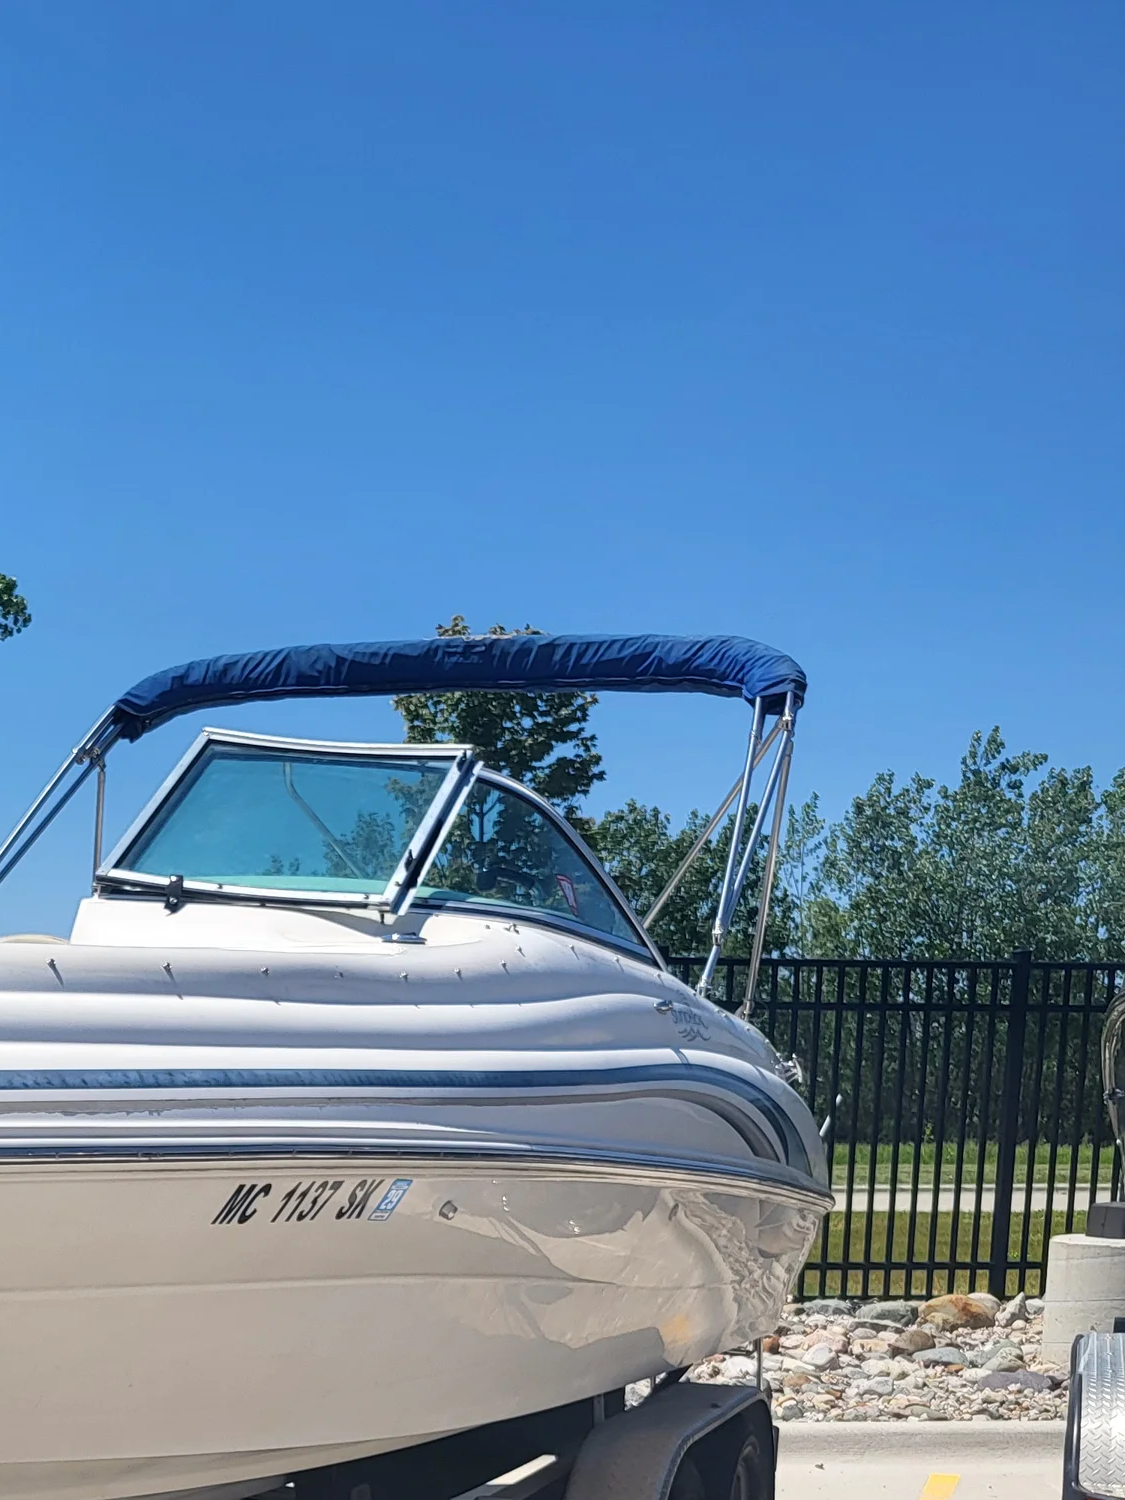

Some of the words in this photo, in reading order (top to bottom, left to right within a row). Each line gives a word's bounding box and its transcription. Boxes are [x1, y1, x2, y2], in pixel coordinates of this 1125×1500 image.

[211, 1183, 272, 1225] MC
[270, 1180, 345, 1222] 1137
[335, 1178, 385, 1220] SK
